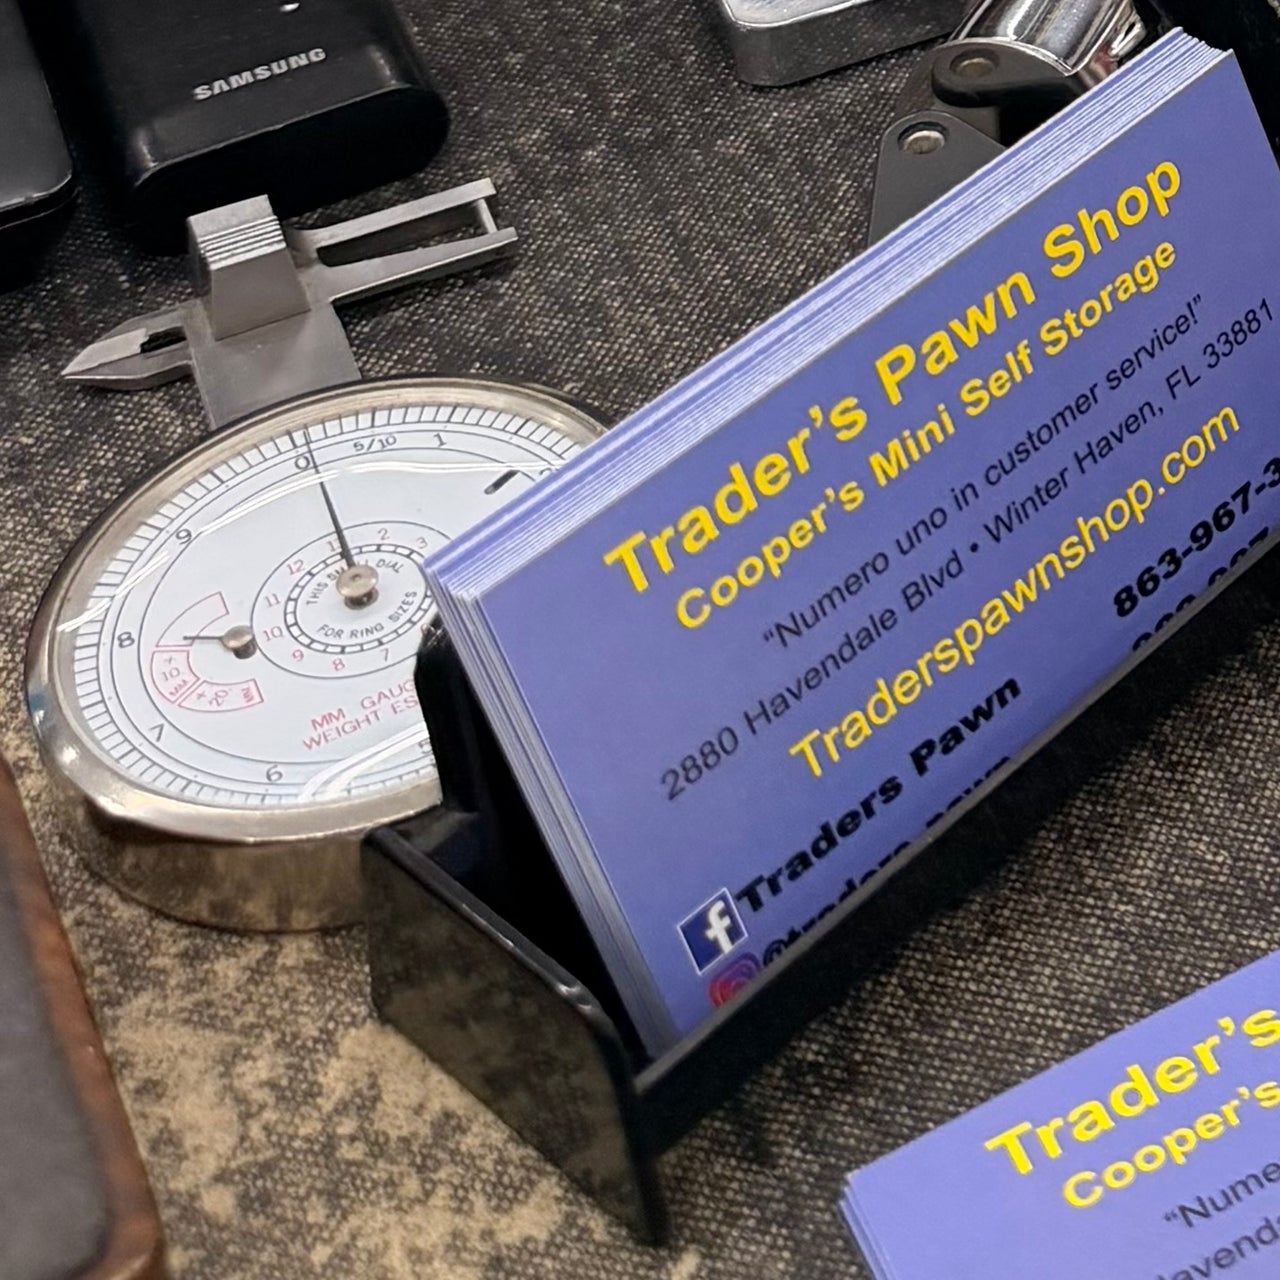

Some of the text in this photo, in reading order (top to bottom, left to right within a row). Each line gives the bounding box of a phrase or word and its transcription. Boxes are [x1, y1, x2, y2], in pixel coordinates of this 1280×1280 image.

[193, 47, 327, 102] SAMSUNG
[874, 270, 1037, 406] Pawn
[1041, 159, 1183, 280] Shop
[869, 402, 956, 488] Mini
[960, 338, 1035, 417] Self
[1045, 241, 1177, 356] Storage
[352, 433, 398, 453] 5/10
[895, 507, 948, 555] uno
[950, 481, 980, 512] in
[984, 383, 1101, 487] customer
[661, 297, 1275, 801] 2880 Havendale Blvd Winter Haven, FL 33881
[305, 581, 329, 607] THIS
[316, 590, 418, 639] FOR RING SIZES
[789, 406, 1241, 778] Traderspawnshop.com
[262, 625, 284, 642] 10
[302, 709, 382, 751] WEIGHT
[311, 707, 346, 732] MM
[736, 775, 904, 913] Traders
[909, 678, 1022, 776] Pawn
